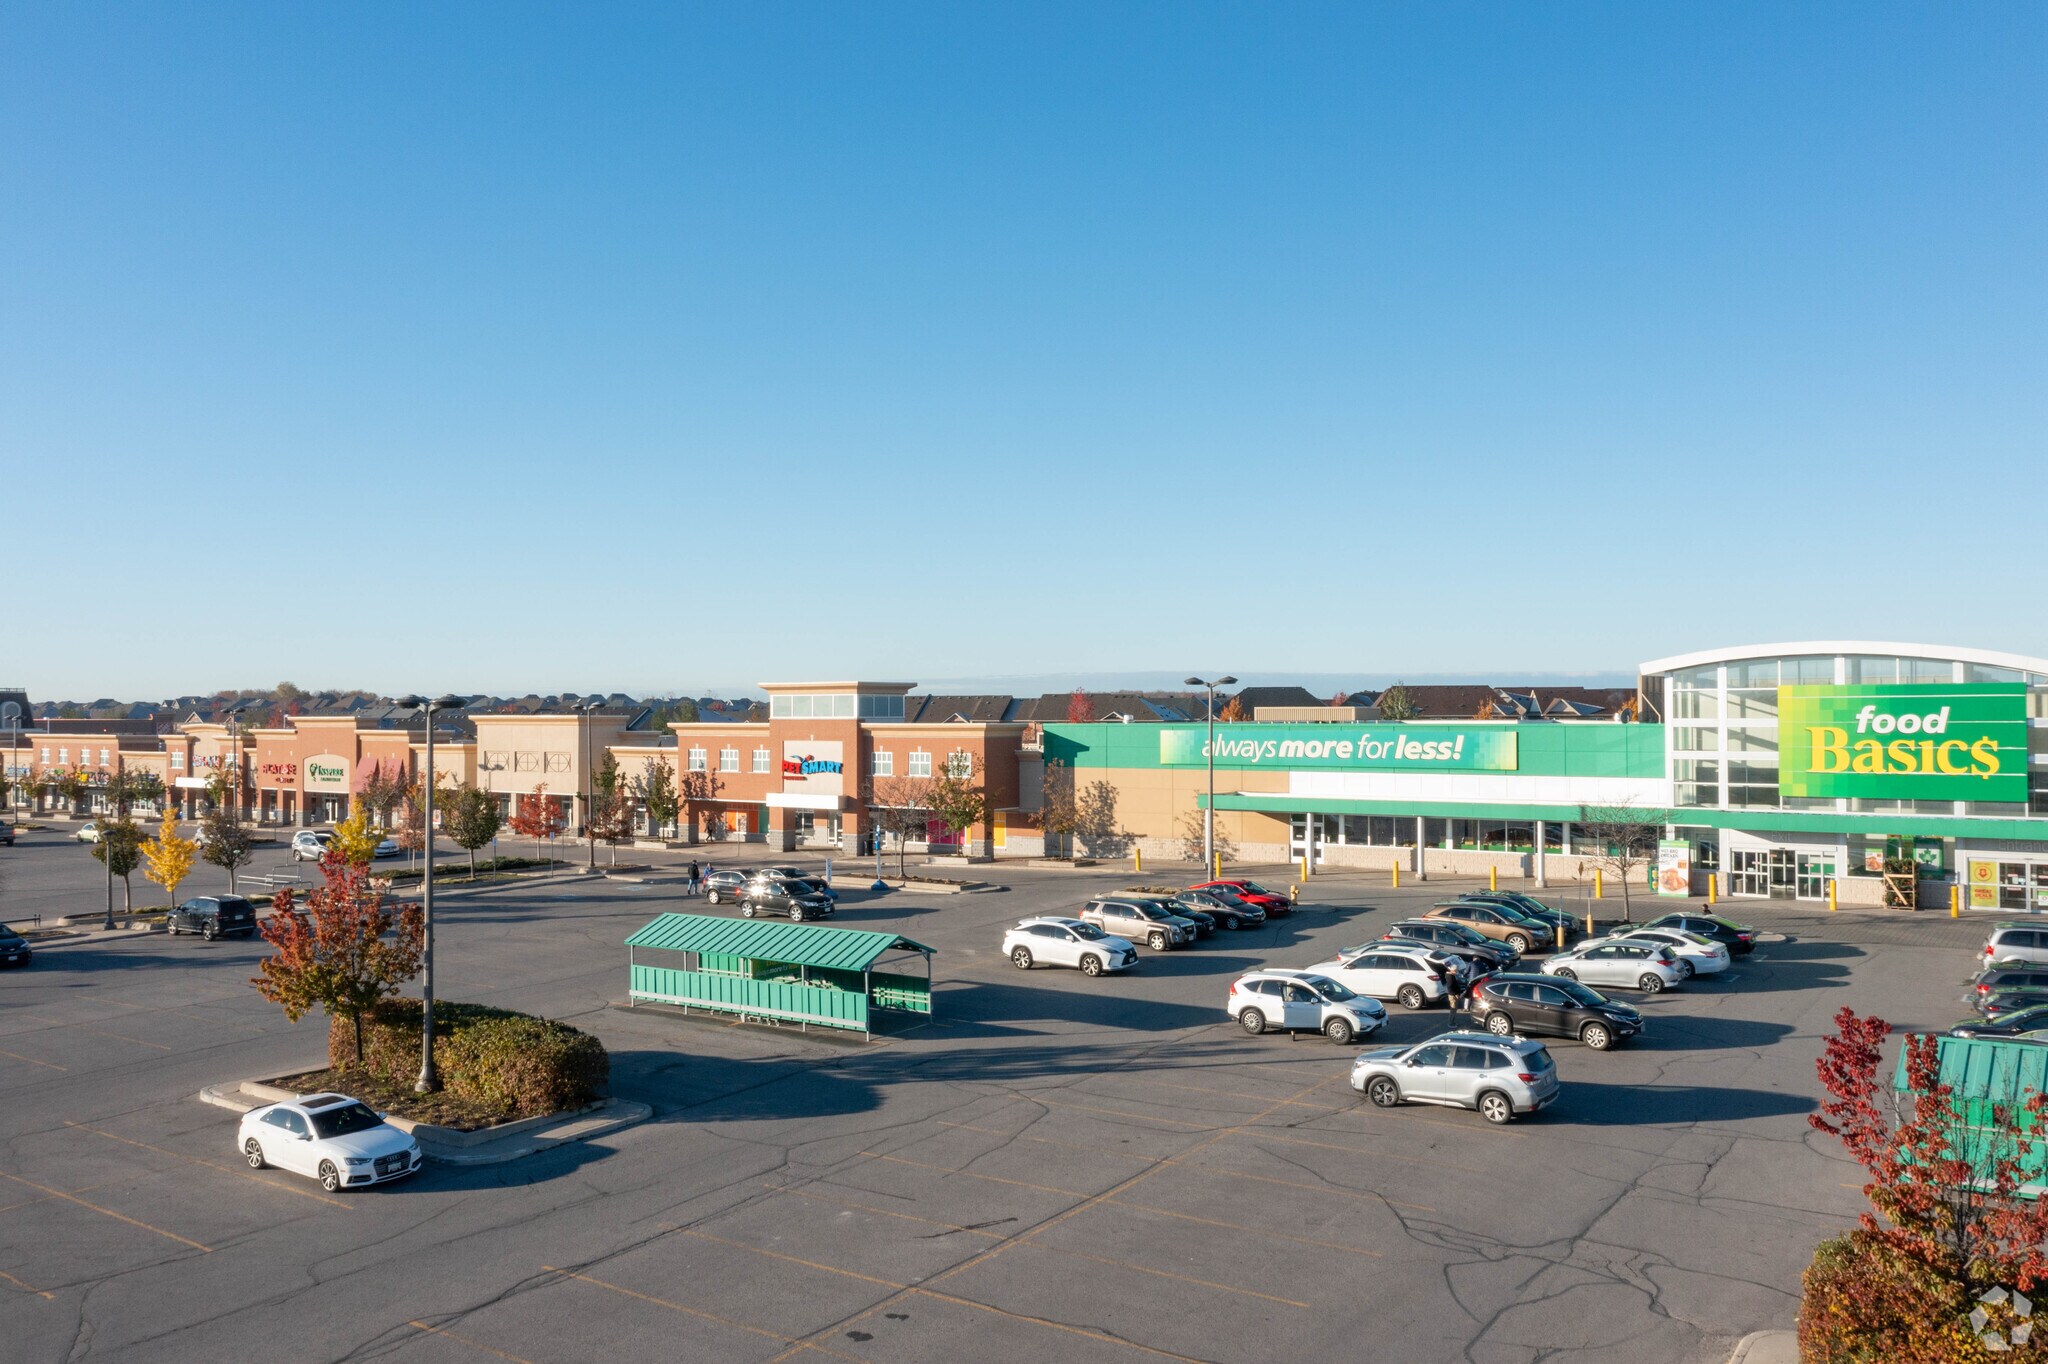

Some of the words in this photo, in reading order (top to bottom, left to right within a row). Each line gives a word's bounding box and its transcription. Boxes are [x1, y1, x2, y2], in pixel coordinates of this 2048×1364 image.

[1855, 705, 1950, 734] food
[1201, 733, 1277, 763] always
[1278, 740, 1354, 759] more
[1356, 733, 1395, 760] for
[1394, 734, 1465, 760] less!
